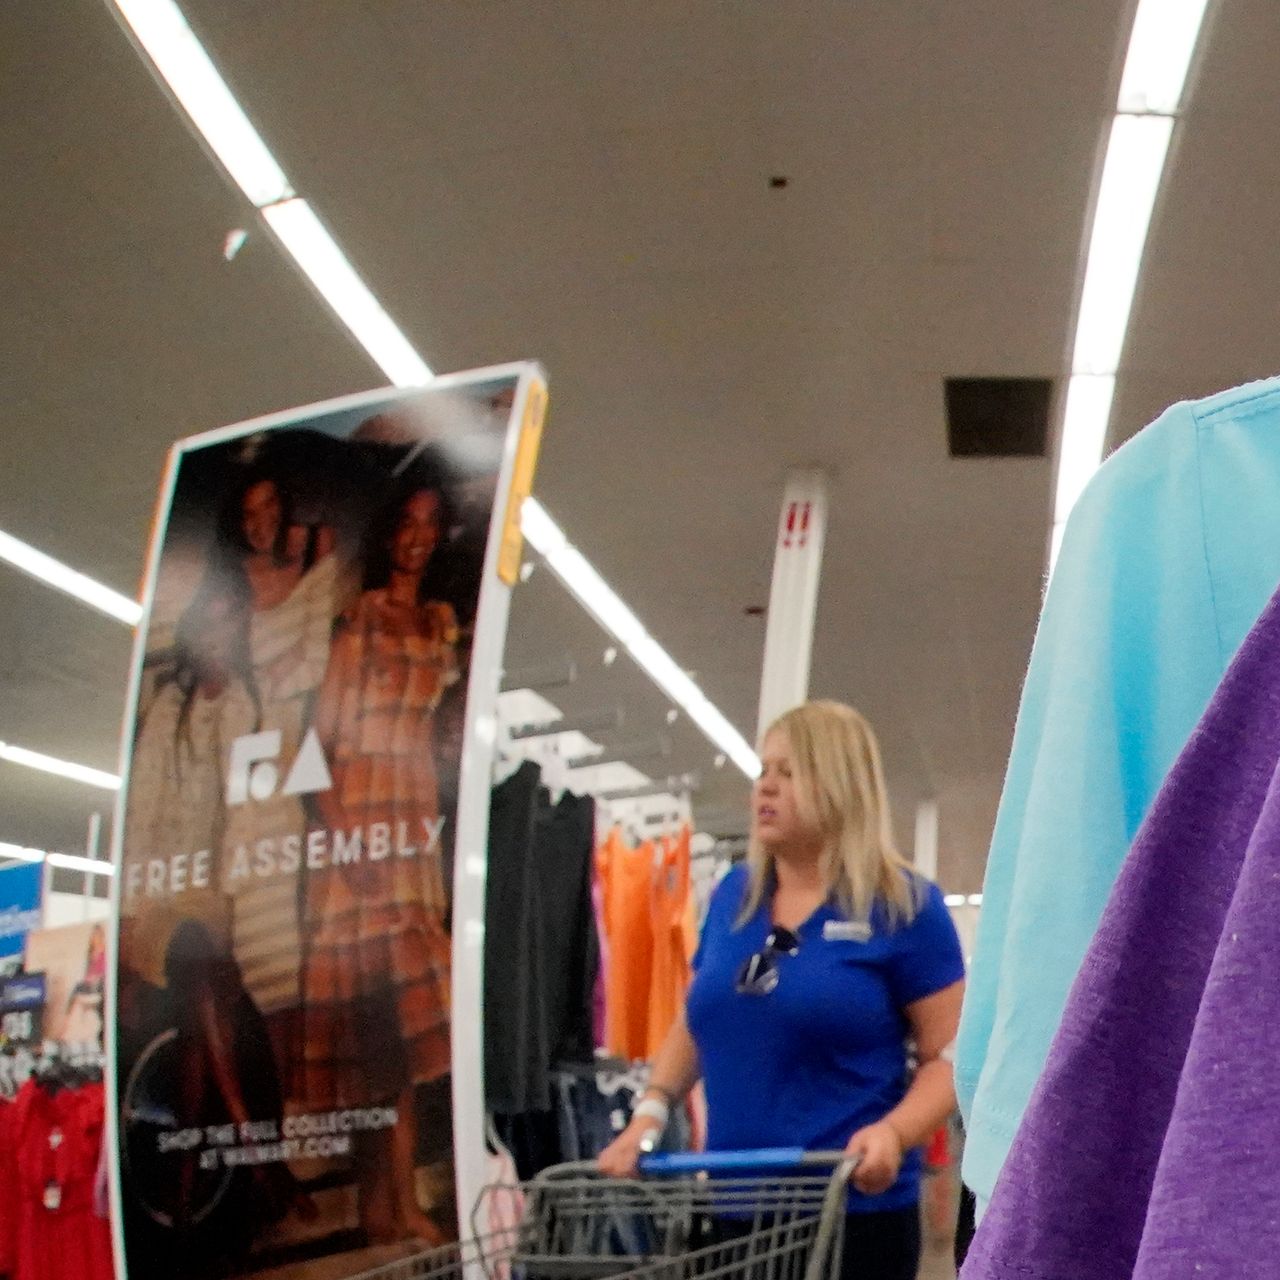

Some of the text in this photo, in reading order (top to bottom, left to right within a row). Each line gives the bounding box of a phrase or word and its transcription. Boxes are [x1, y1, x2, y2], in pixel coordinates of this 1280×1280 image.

[126, 814, 446, 897] FREE ASSEMBLY
[282, 1106, 398, 1138] COLLECTION
